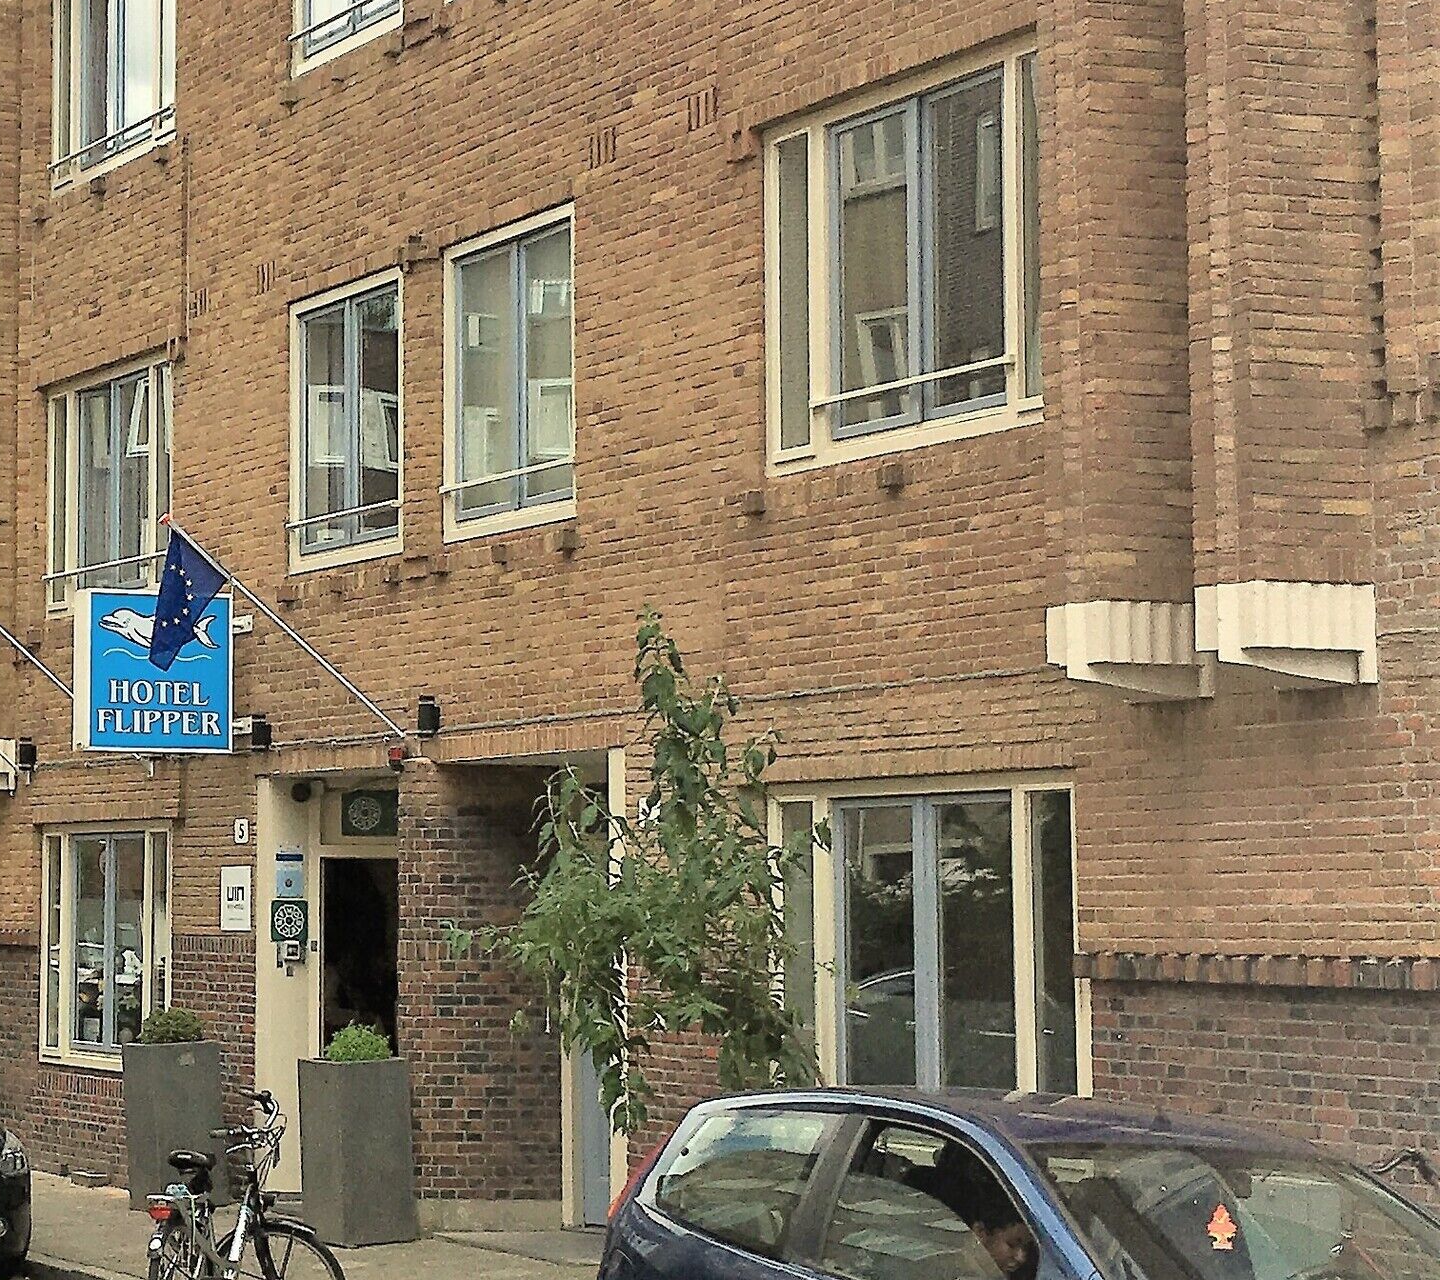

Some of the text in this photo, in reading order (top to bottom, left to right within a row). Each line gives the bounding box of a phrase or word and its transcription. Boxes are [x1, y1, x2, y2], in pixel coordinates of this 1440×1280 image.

[108, 679, 210, 706] HOTEL
[97, 708, 221, 735] FLIPPER
[239, 823, 245, 839] 5
